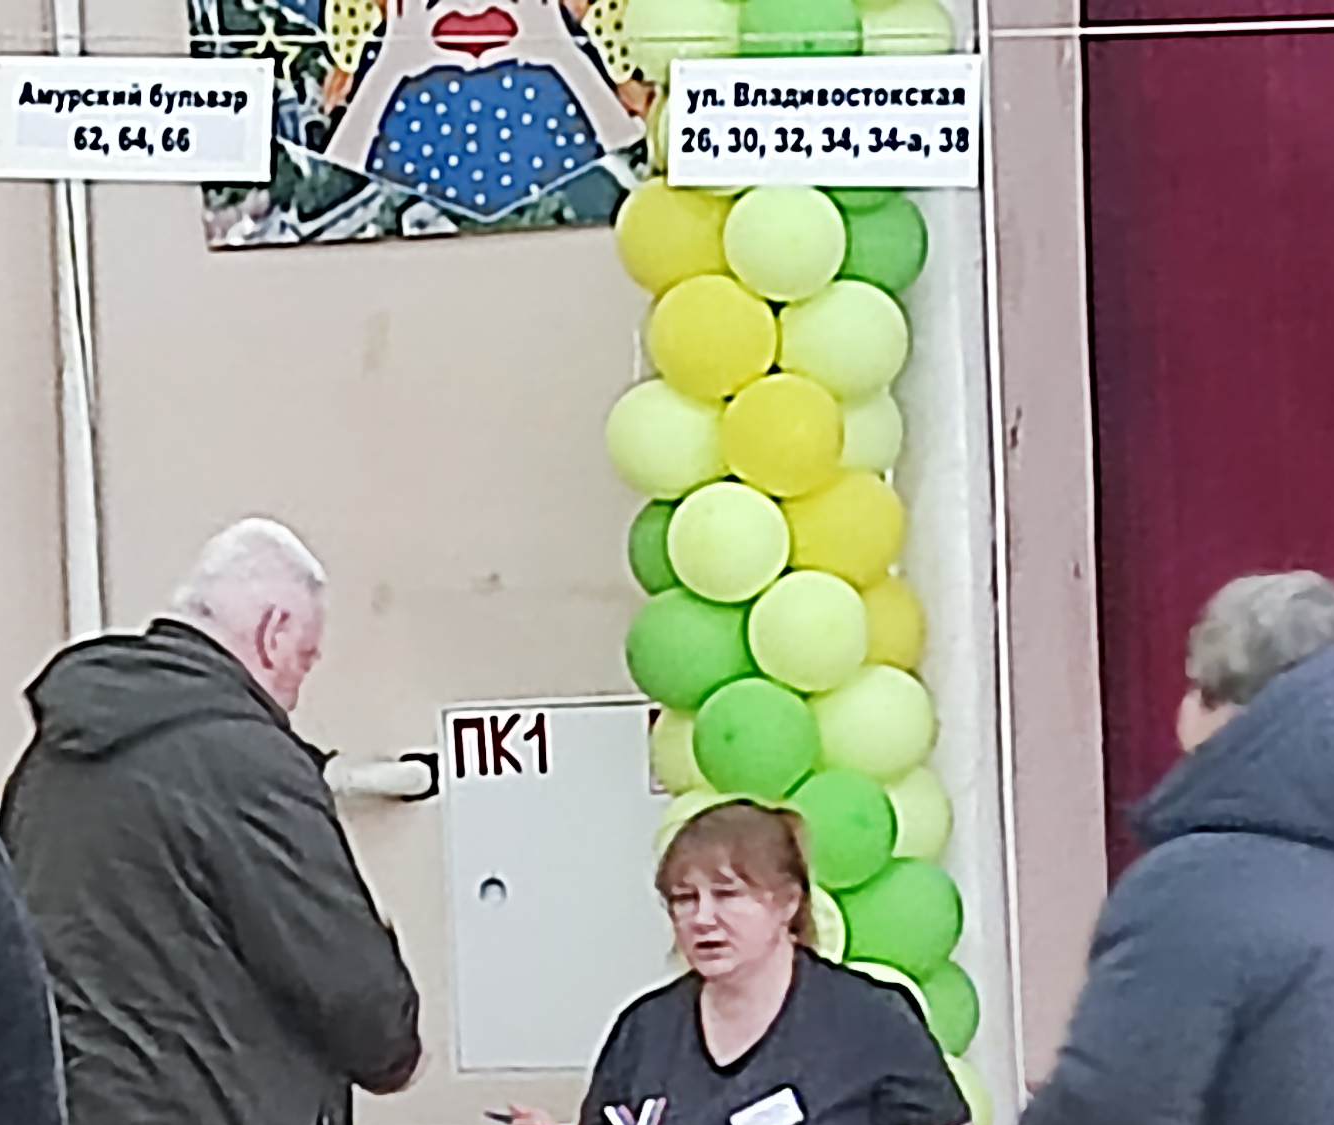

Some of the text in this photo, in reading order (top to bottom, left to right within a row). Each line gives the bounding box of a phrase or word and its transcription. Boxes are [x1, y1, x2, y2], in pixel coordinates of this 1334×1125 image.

[19, 81, 247, 114] Амурский бульвар
[687, 82, 965, 114] ул. Владивостокская
[74, 126, 190, 156] 62, 64, 66
[681, 127, 969, 158] 26, 30, 32, 34, 34-а, 38
[451, 712, 548, 778] ПК1
